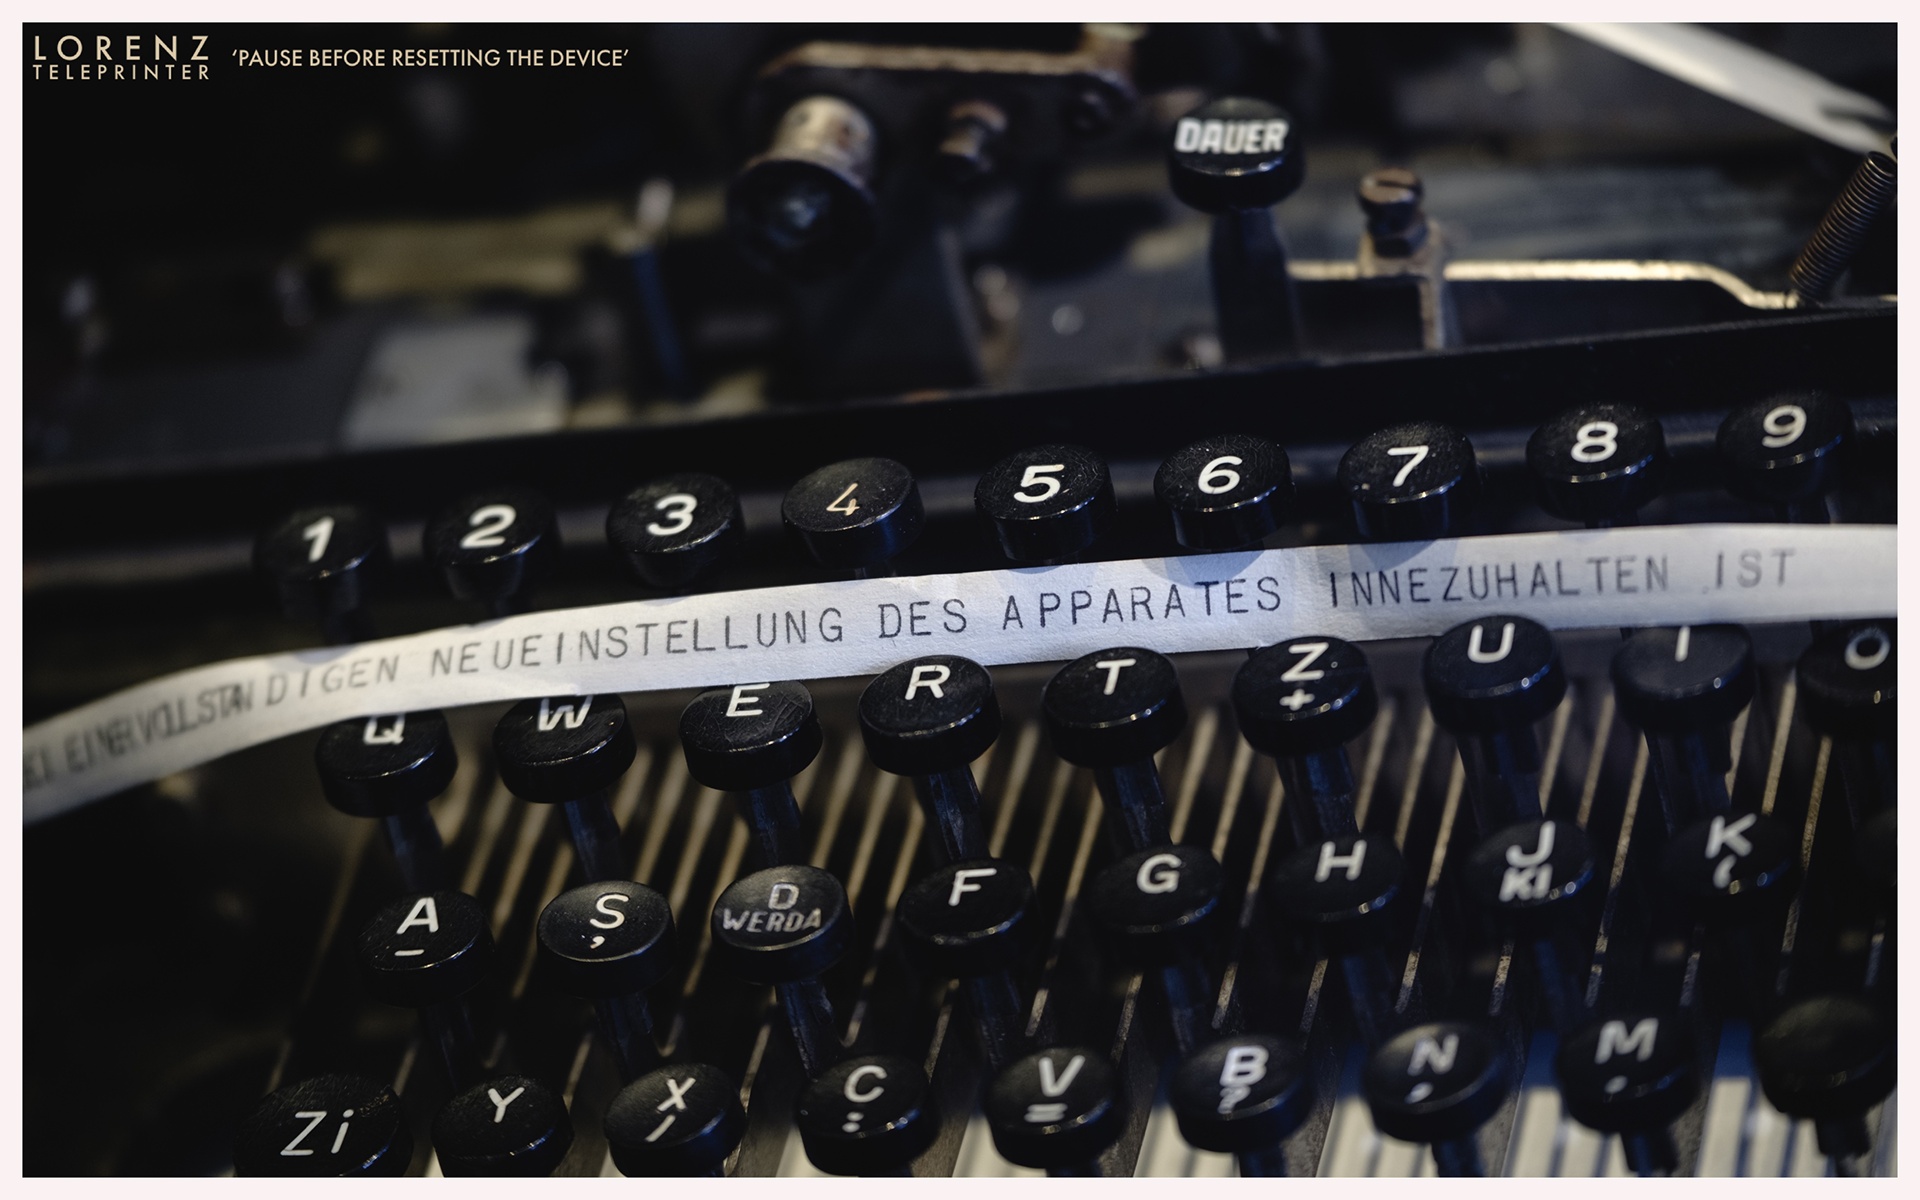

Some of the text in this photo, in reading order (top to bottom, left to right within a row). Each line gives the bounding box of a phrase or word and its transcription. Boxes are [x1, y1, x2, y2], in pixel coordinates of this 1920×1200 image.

[1175, 118, 1289, 154] DAUER
[1571, 421, 1619, 463] 8
[1762, 404, 1808, 448] 9
[1012, 462, 1066, 503] 5
[1196, 454, 1243, 495] 6
[1386, 445, 1432, 487] 7
[646, 493, 698, 536] 3
[825, 482, 860, 516] 4
[304, 517, 334, 563] 1
[461, 505, 516, 550] 2
[431, 606, 844, 676] NEUEINSTELLUNG
[877, 598, 969, 638] DES
[1001, 575, 1283, 632] APPARATES
[1329, 556, 1670, 609] INNEZUHALTEN
[1280, 641, 1331, 682] Z
[1467, 621, 1516, 664] U
[1674, 626, 1691, 662] I
[1844, 625, 1892, 671] O
[904, 664, 951, 700] R
[1095, 657, 1137, 696] T
[536, 694, 593, 732] W
[725, 682, 770, 717] E
[1505, 820, 1556, 868] J
[1704, 813, 1758, 859] K
[1136, 853, 1183, 894] G
[1315, 839, 1368, 882] H
[768, 881, 800, 910] D
[948, 867, 998, 906] F
[396, 896, 440, 935] A
[588, 893, 630, 930] S
[722, 906, 822, 933] WERDA
[1406, 1032, 1460, 1076] N
[1594, 1017, 1660, 1064] M
[843, 1064, 888, 1102] C
[1037, 1054, 1086, 1097] V
[1219, 1045, 1269, 1087] B
[486, 1086, 525, 1123] Y
[656, 1076, 697, 1112] X
[279, 1108, 355, 1156] Zi
